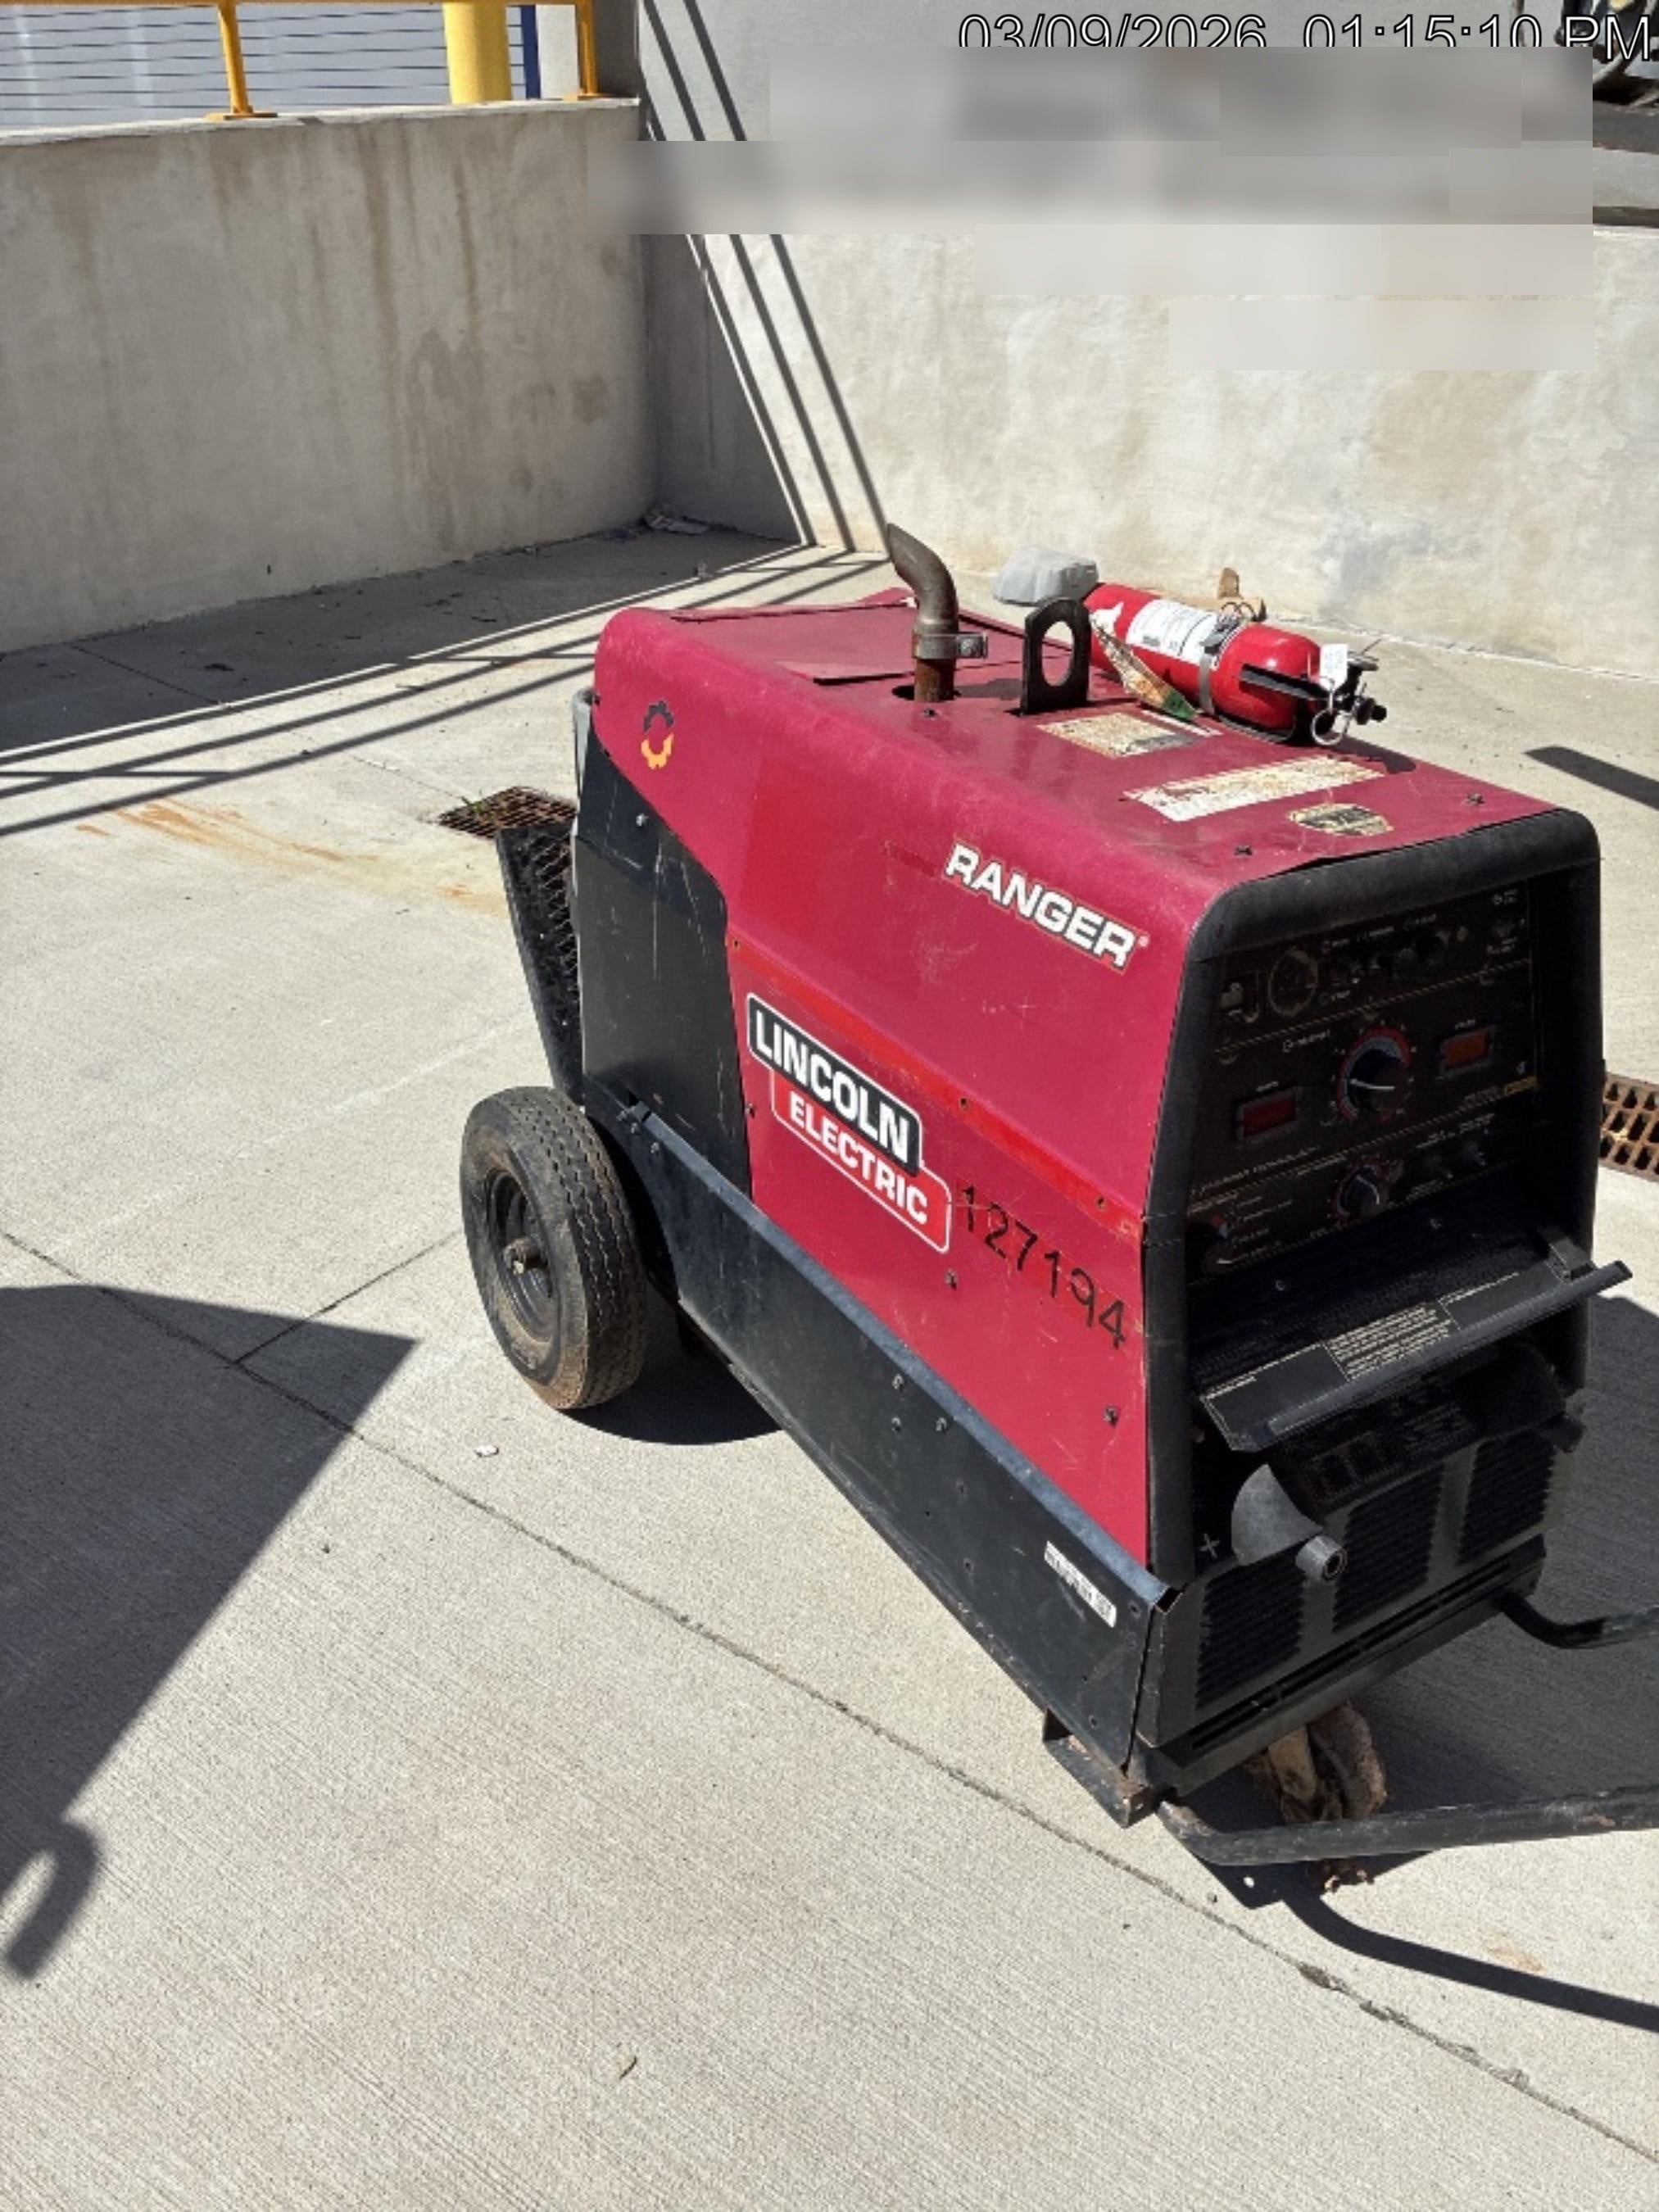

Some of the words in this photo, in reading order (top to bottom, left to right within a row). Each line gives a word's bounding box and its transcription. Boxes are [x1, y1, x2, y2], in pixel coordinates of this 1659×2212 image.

[945, 842, 1136, 968] RANGER
[755, 1009, 909, 1164] LINCOLN
[789, 1090, 928, 1226] ELECTRIC
[963, 1185, 1126, 1350] 127194
